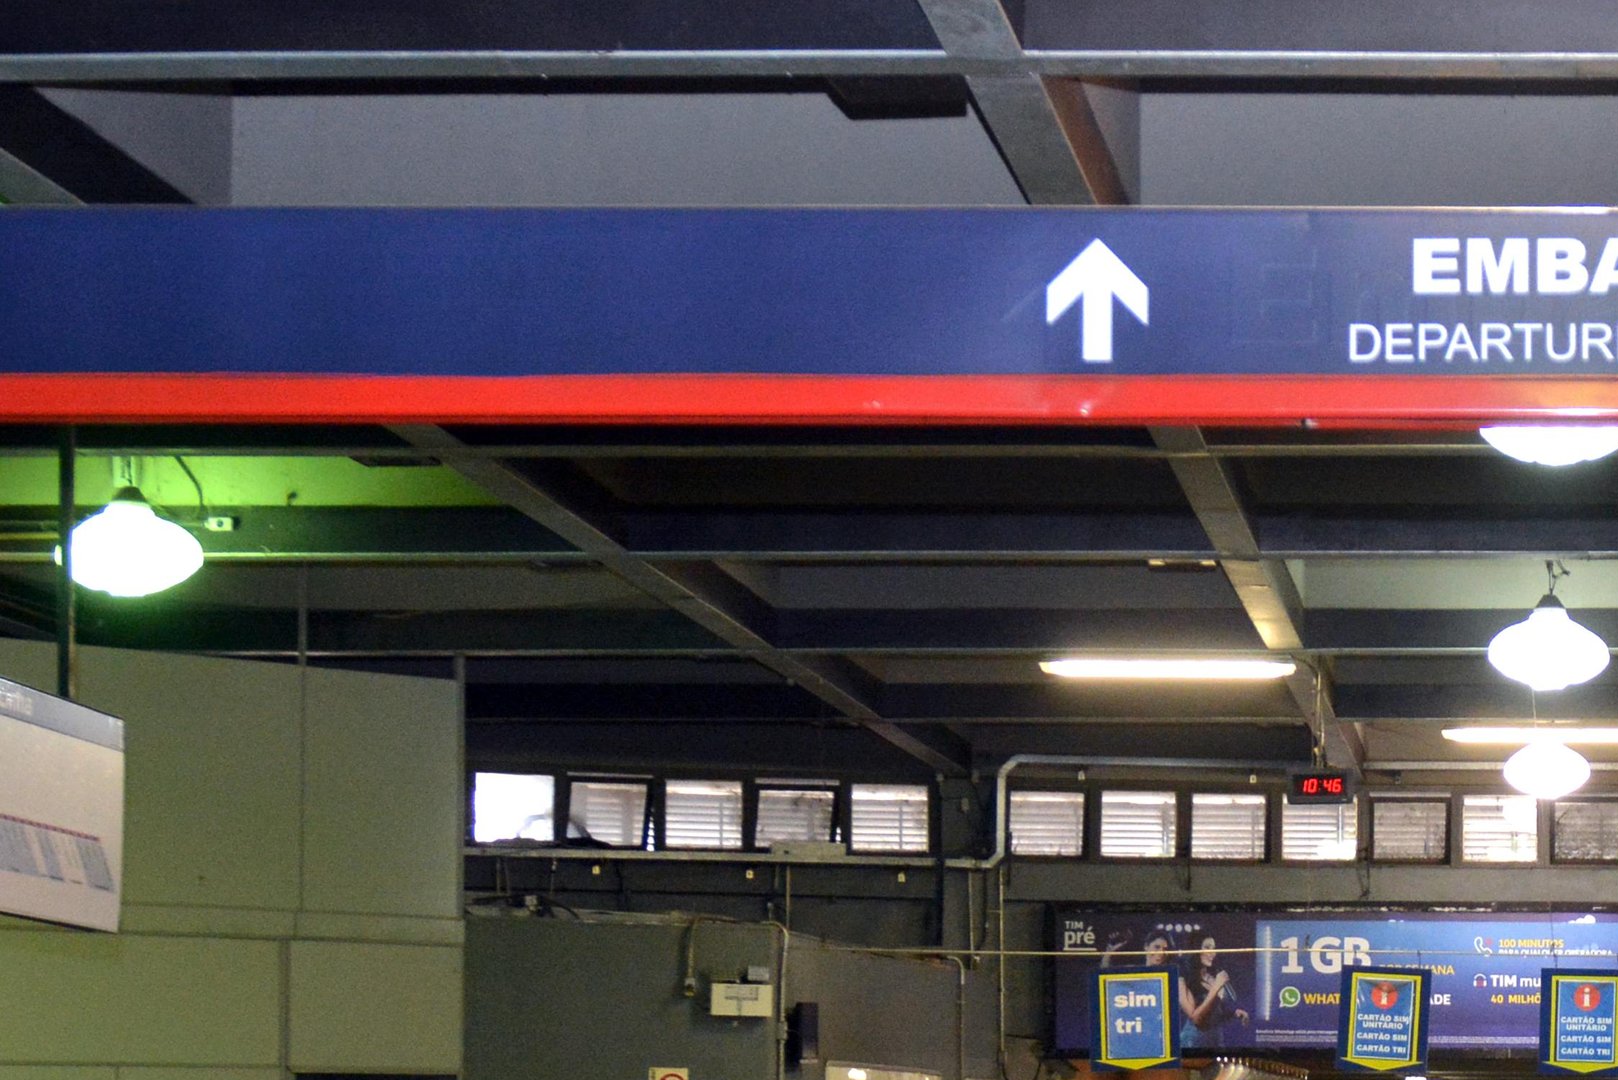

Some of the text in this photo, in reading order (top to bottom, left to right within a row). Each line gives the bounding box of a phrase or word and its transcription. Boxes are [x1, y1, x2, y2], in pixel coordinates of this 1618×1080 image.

[1064, 921, 1083, 929] TIM
[1064, 927, 1095, 949] pré
[1518, 938, 1564, 948] MINUTOS
[1490, 974, 1517, 987] TIM
[1114, 991, 1156, 1008] sim
[1491, 995, 1503, 1004] 40
[1358, 1013, 1391, 1022] CARTÃO
[1561, 1015, 1595, 1024] CARTÃO
[1115, 1017, 1142, 1033] tri
[1362, 1020, 1403, 1030] UNITÁRIO
[1566, 1022, 1607, 1031] UNITÁRIO
[1357, 1032, 1390, 1041] CARTÃO
[1561, 1034, 1611, 1043] CARTÃO SIM
[1357, 1044, 1390, 1053] CARTÃO
[1561, 1046, 1594, 1055] CARTÃO
